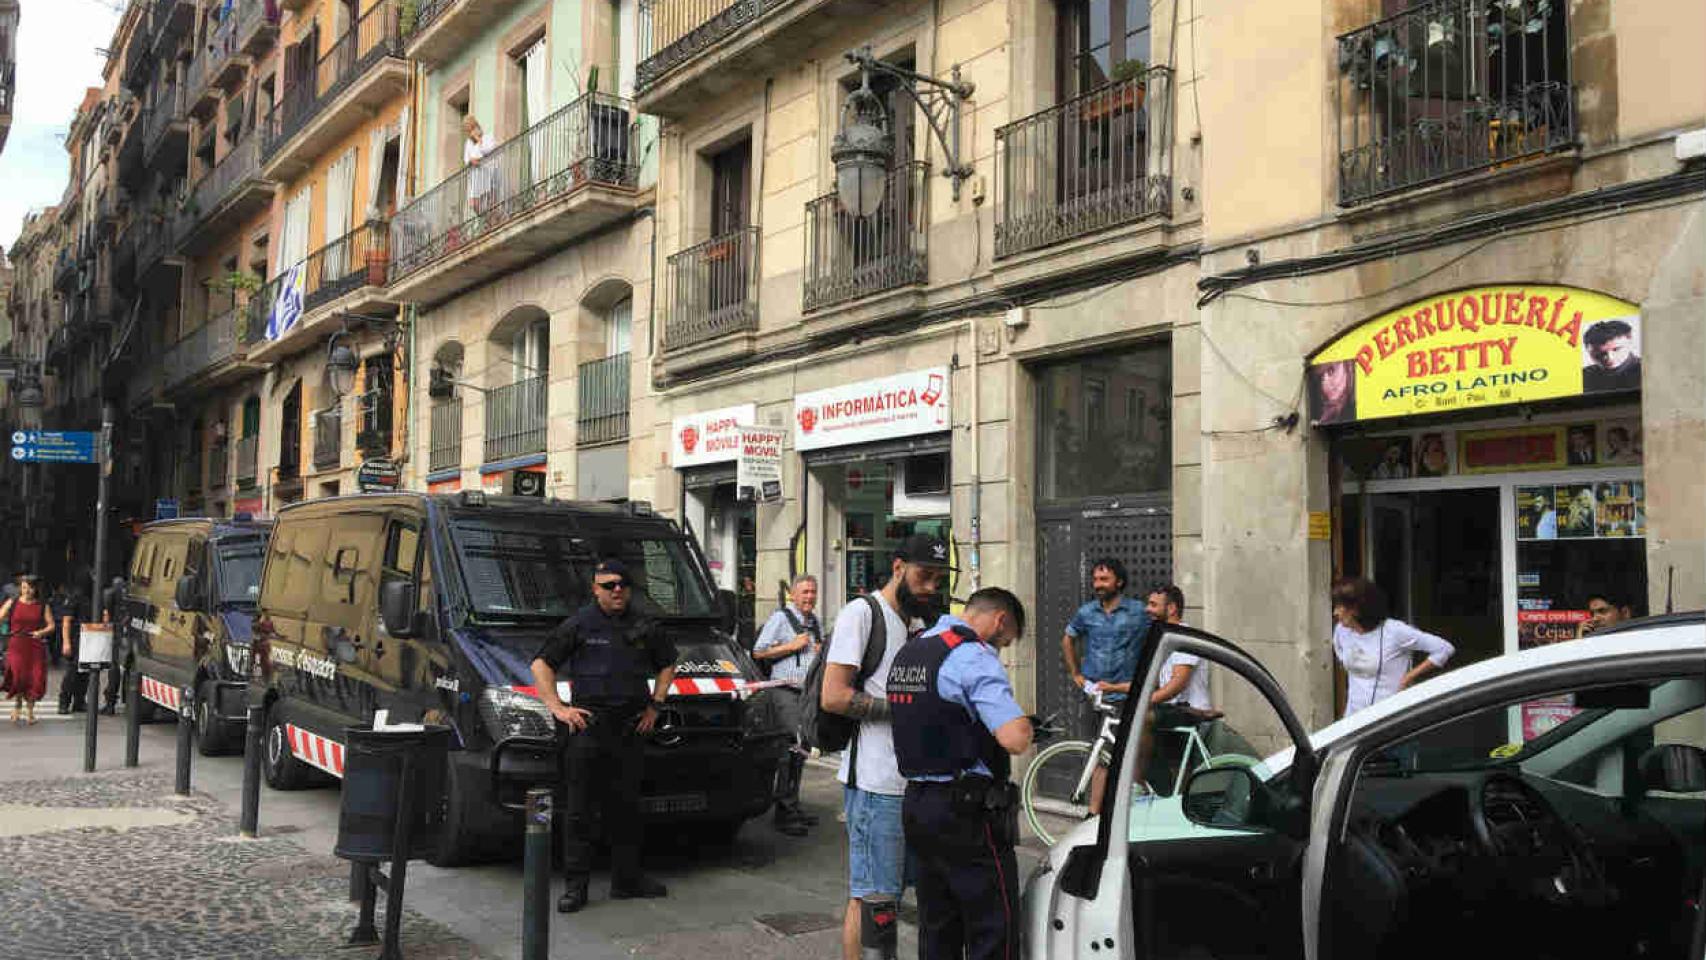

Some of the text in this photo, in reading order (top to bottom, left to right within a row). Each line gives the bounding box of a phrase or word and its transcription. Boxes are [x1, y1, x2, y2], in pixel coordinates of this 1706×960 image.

[1355, 289, 1584, 376] PERRUQUERÍA
[1406, 336, 1518, 378] BETTY
[1382, 368, 1549, 400] AFRO LATINO
[822, 388, 918, 421] INFORMÁTICA
[743, 432, 781, 444] HAPPY
[675, 660, 721, 673] olicia
